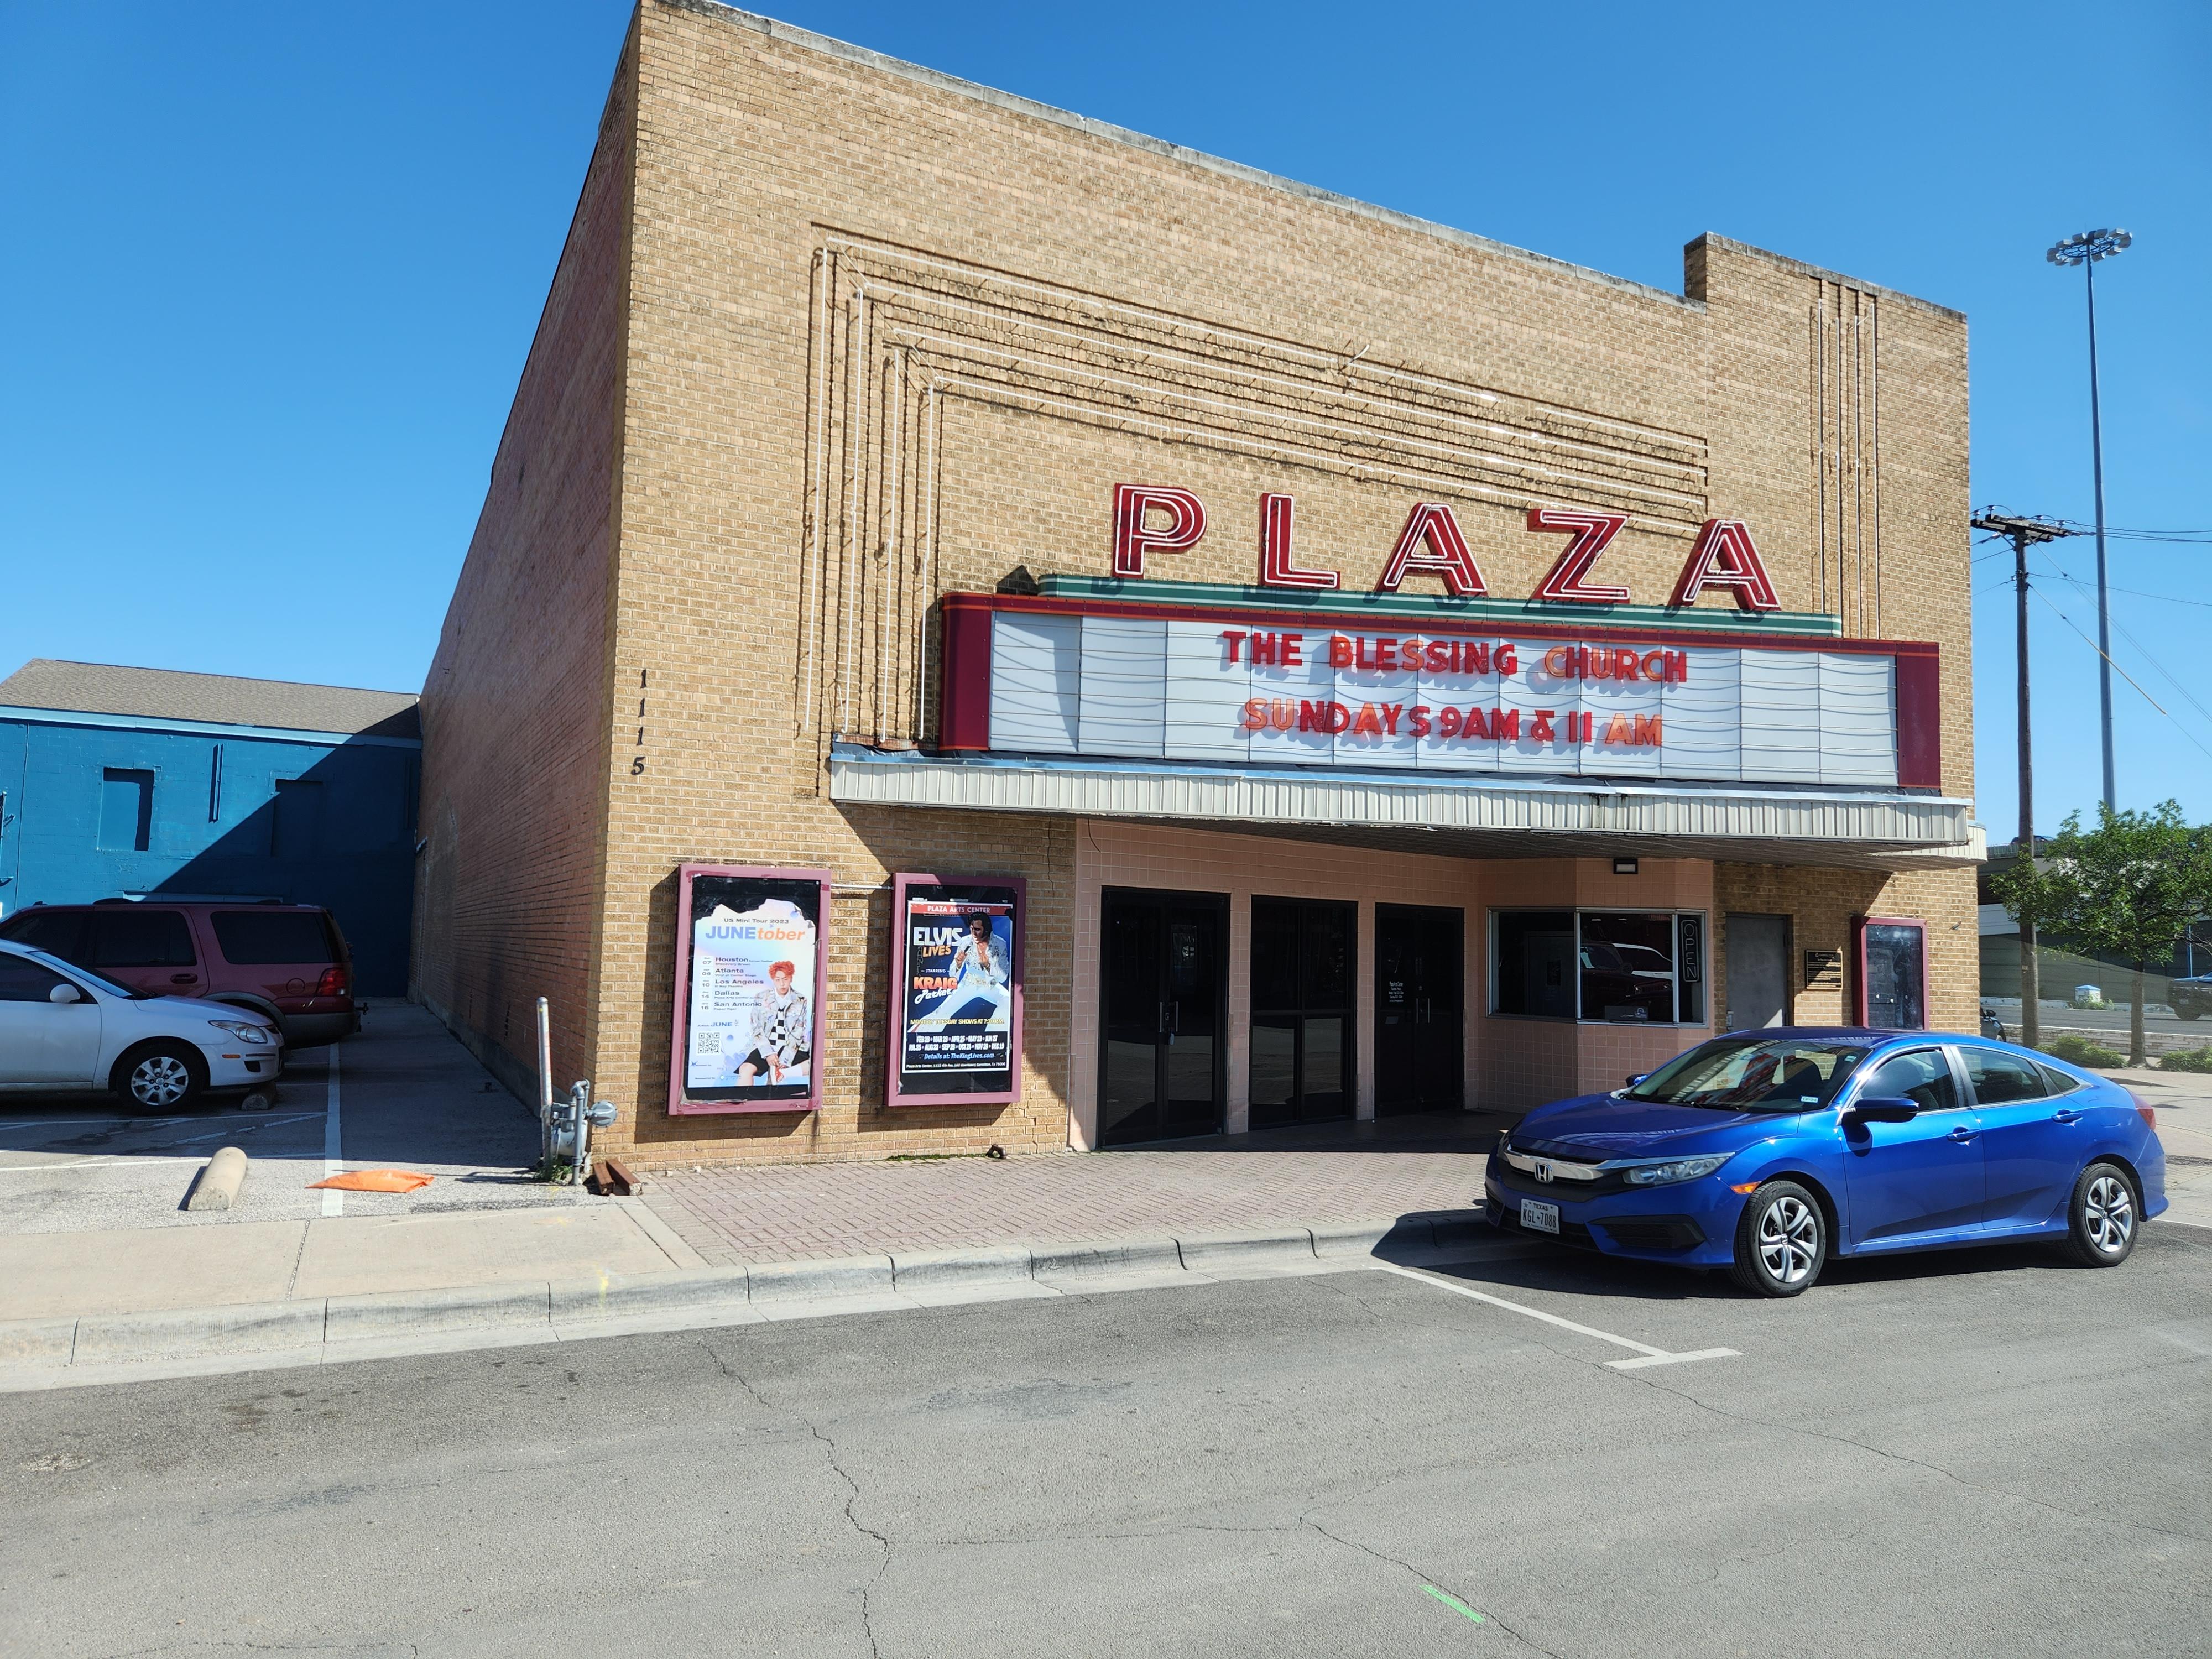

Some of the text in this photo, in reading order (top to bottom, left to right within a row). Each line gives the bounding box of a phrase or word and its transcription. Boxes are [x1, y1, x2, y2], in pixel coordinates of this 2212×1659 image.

[1112, 483, 1782, 611] PLAZA
[1223, 631, 1687, 682] THE BLESSING CHURCH
[631, 669, 646, 775] 1115
[1245, 698, 1431, 737] SUNDAYS
[1441, 706, 1519, 740] 9AM
[1605, 713, 1662, 746] AM
[914, 927, 962, 946] ELVIS
[923, 945, 951, 957] LIVES
[1683, 924, 1697, 979] OPEN
[914, 977, 957, 989] KRAIG
[914, 987, 951, 1004] Parker
